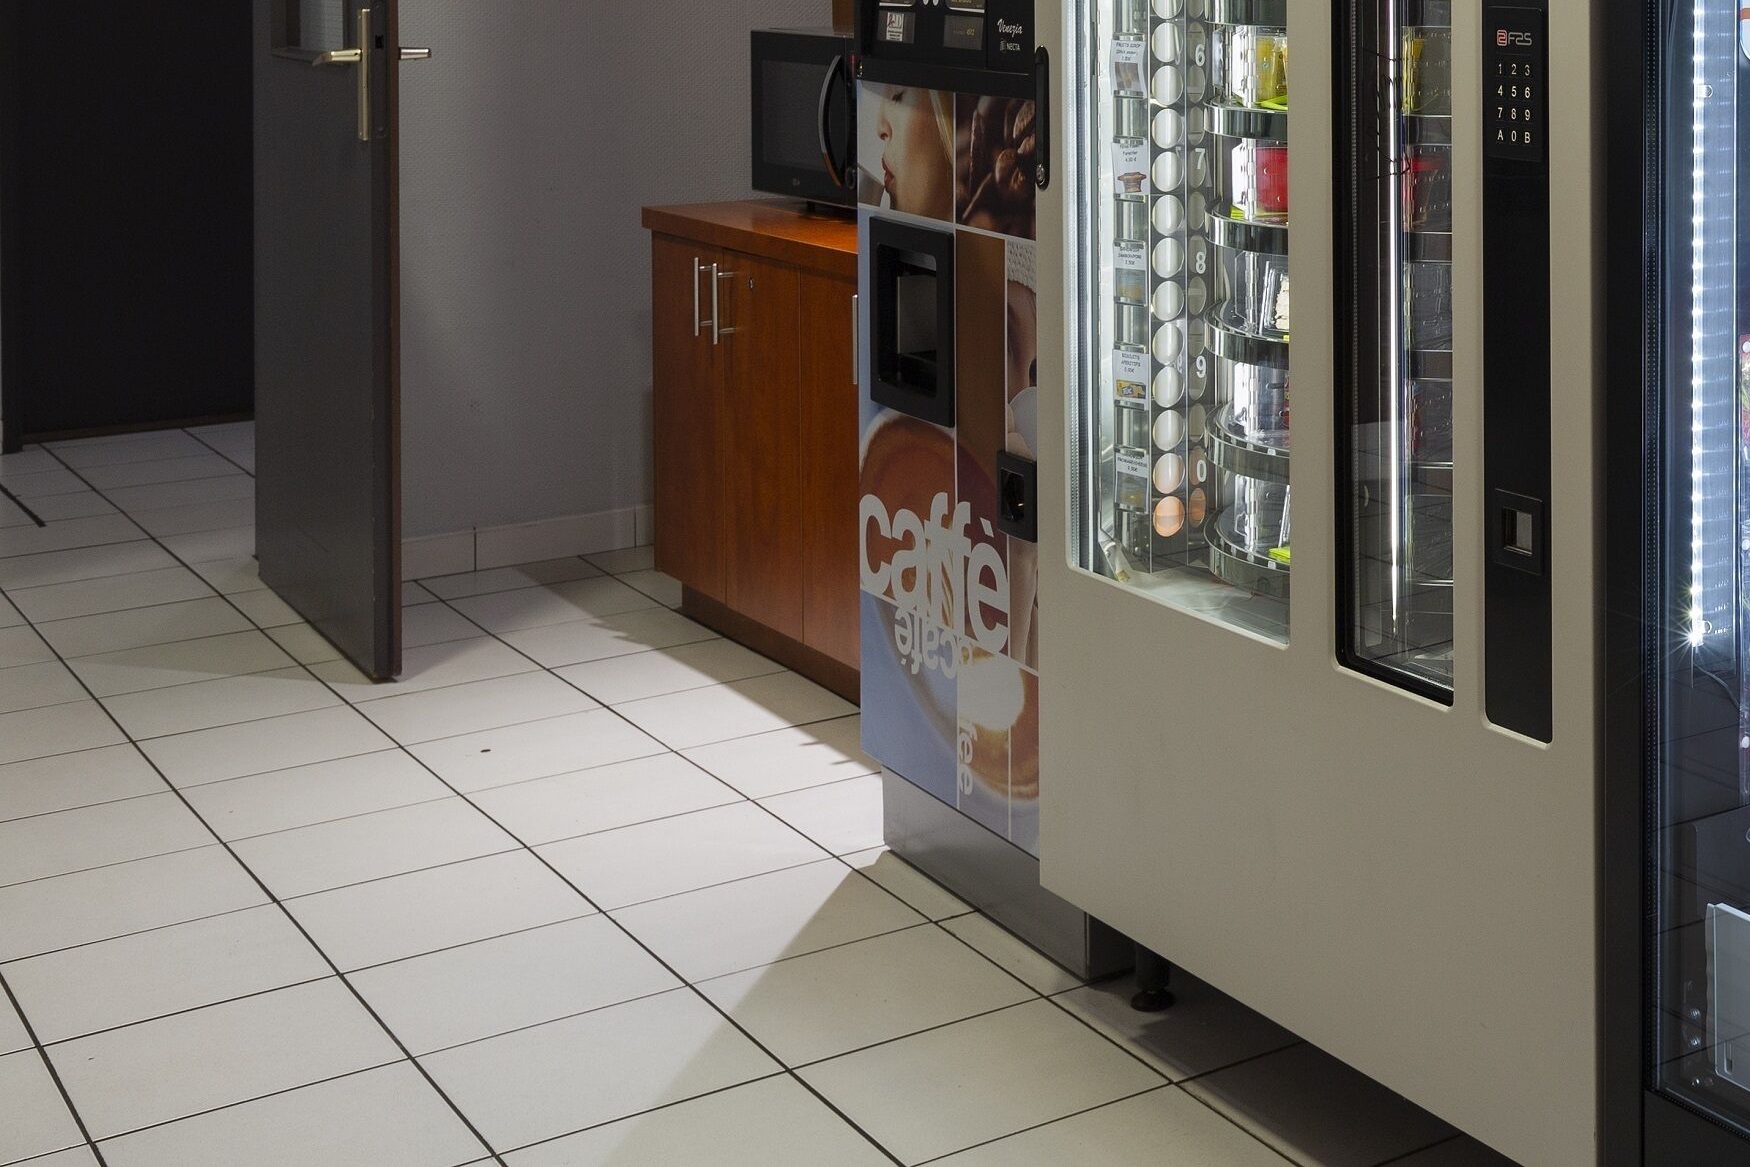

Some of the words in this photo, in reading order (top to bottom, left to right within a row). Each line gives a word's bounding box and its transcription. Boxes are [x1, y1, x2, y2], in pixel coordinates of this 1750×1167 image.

[997, 18, 1022, 38] Venezia
[1006, 43, 1020, 51] NECTA
[1195, 44, 1205, 66] 6
[1499, 64, 1502, 74] 1
[1511, 64, 1516, 74] 2
[1525, 64, 1530, 76] 3
[1498, 85, 1503, 96] 4
[1511, 86, 1516, 97] 5
[1525, 87, 1530, 98] 6
[1497, 107, 1503, 118] 7
[1511, 108, 1516, 120] 8
[1525, 109, 1530, 121] 9
[1497, 129, 1503, 141] A
[1511, 130, 1516, 142] 0
[1525, 132, 1530, 143] B
[1195, 252, 1206, 274] 8
[1196, 356, 1206, 378] 9
[859, 492, 1011, 653] caffè
